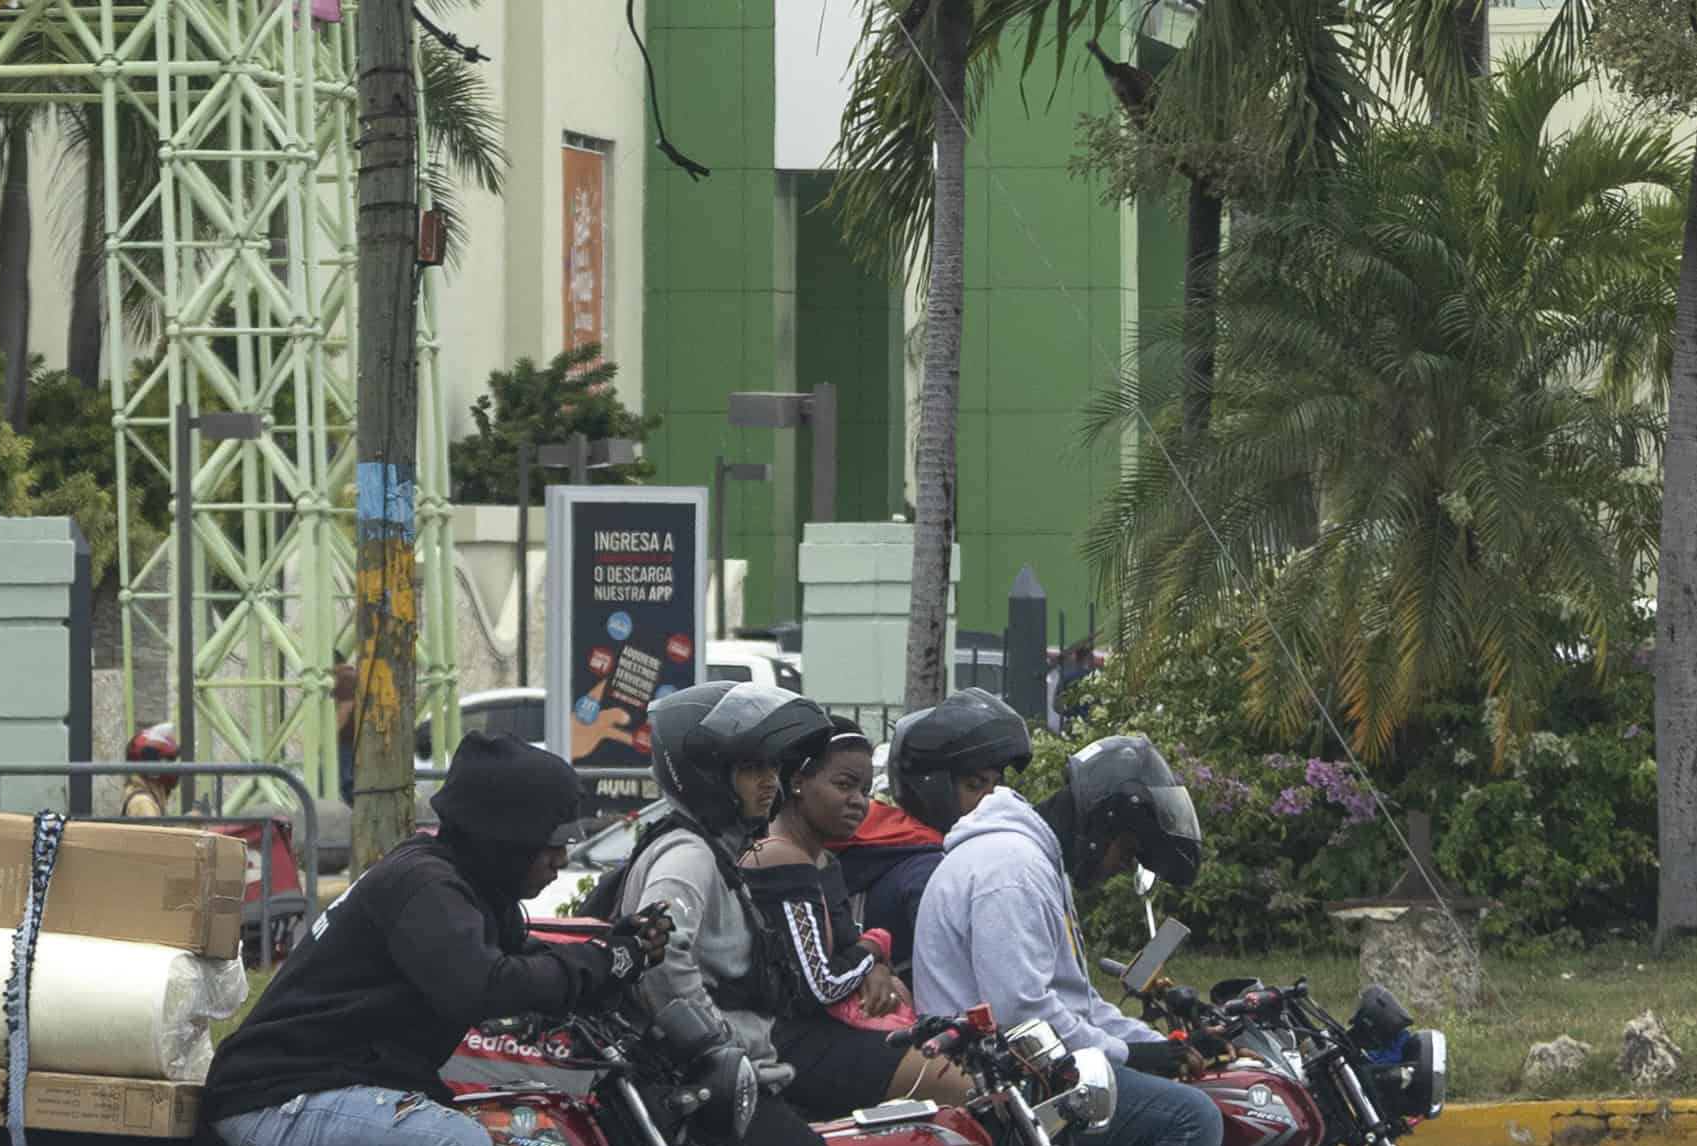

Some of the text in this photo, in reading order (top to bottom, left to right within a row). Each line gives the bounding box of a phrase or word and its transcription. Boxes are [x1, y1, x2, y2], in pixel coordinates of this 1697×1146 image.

[594, 531, 675, 552] INGRESA A
[593, 566, 673, 583] O DESCARGA
[593, 585, 673, 601] NUESTRA APP
